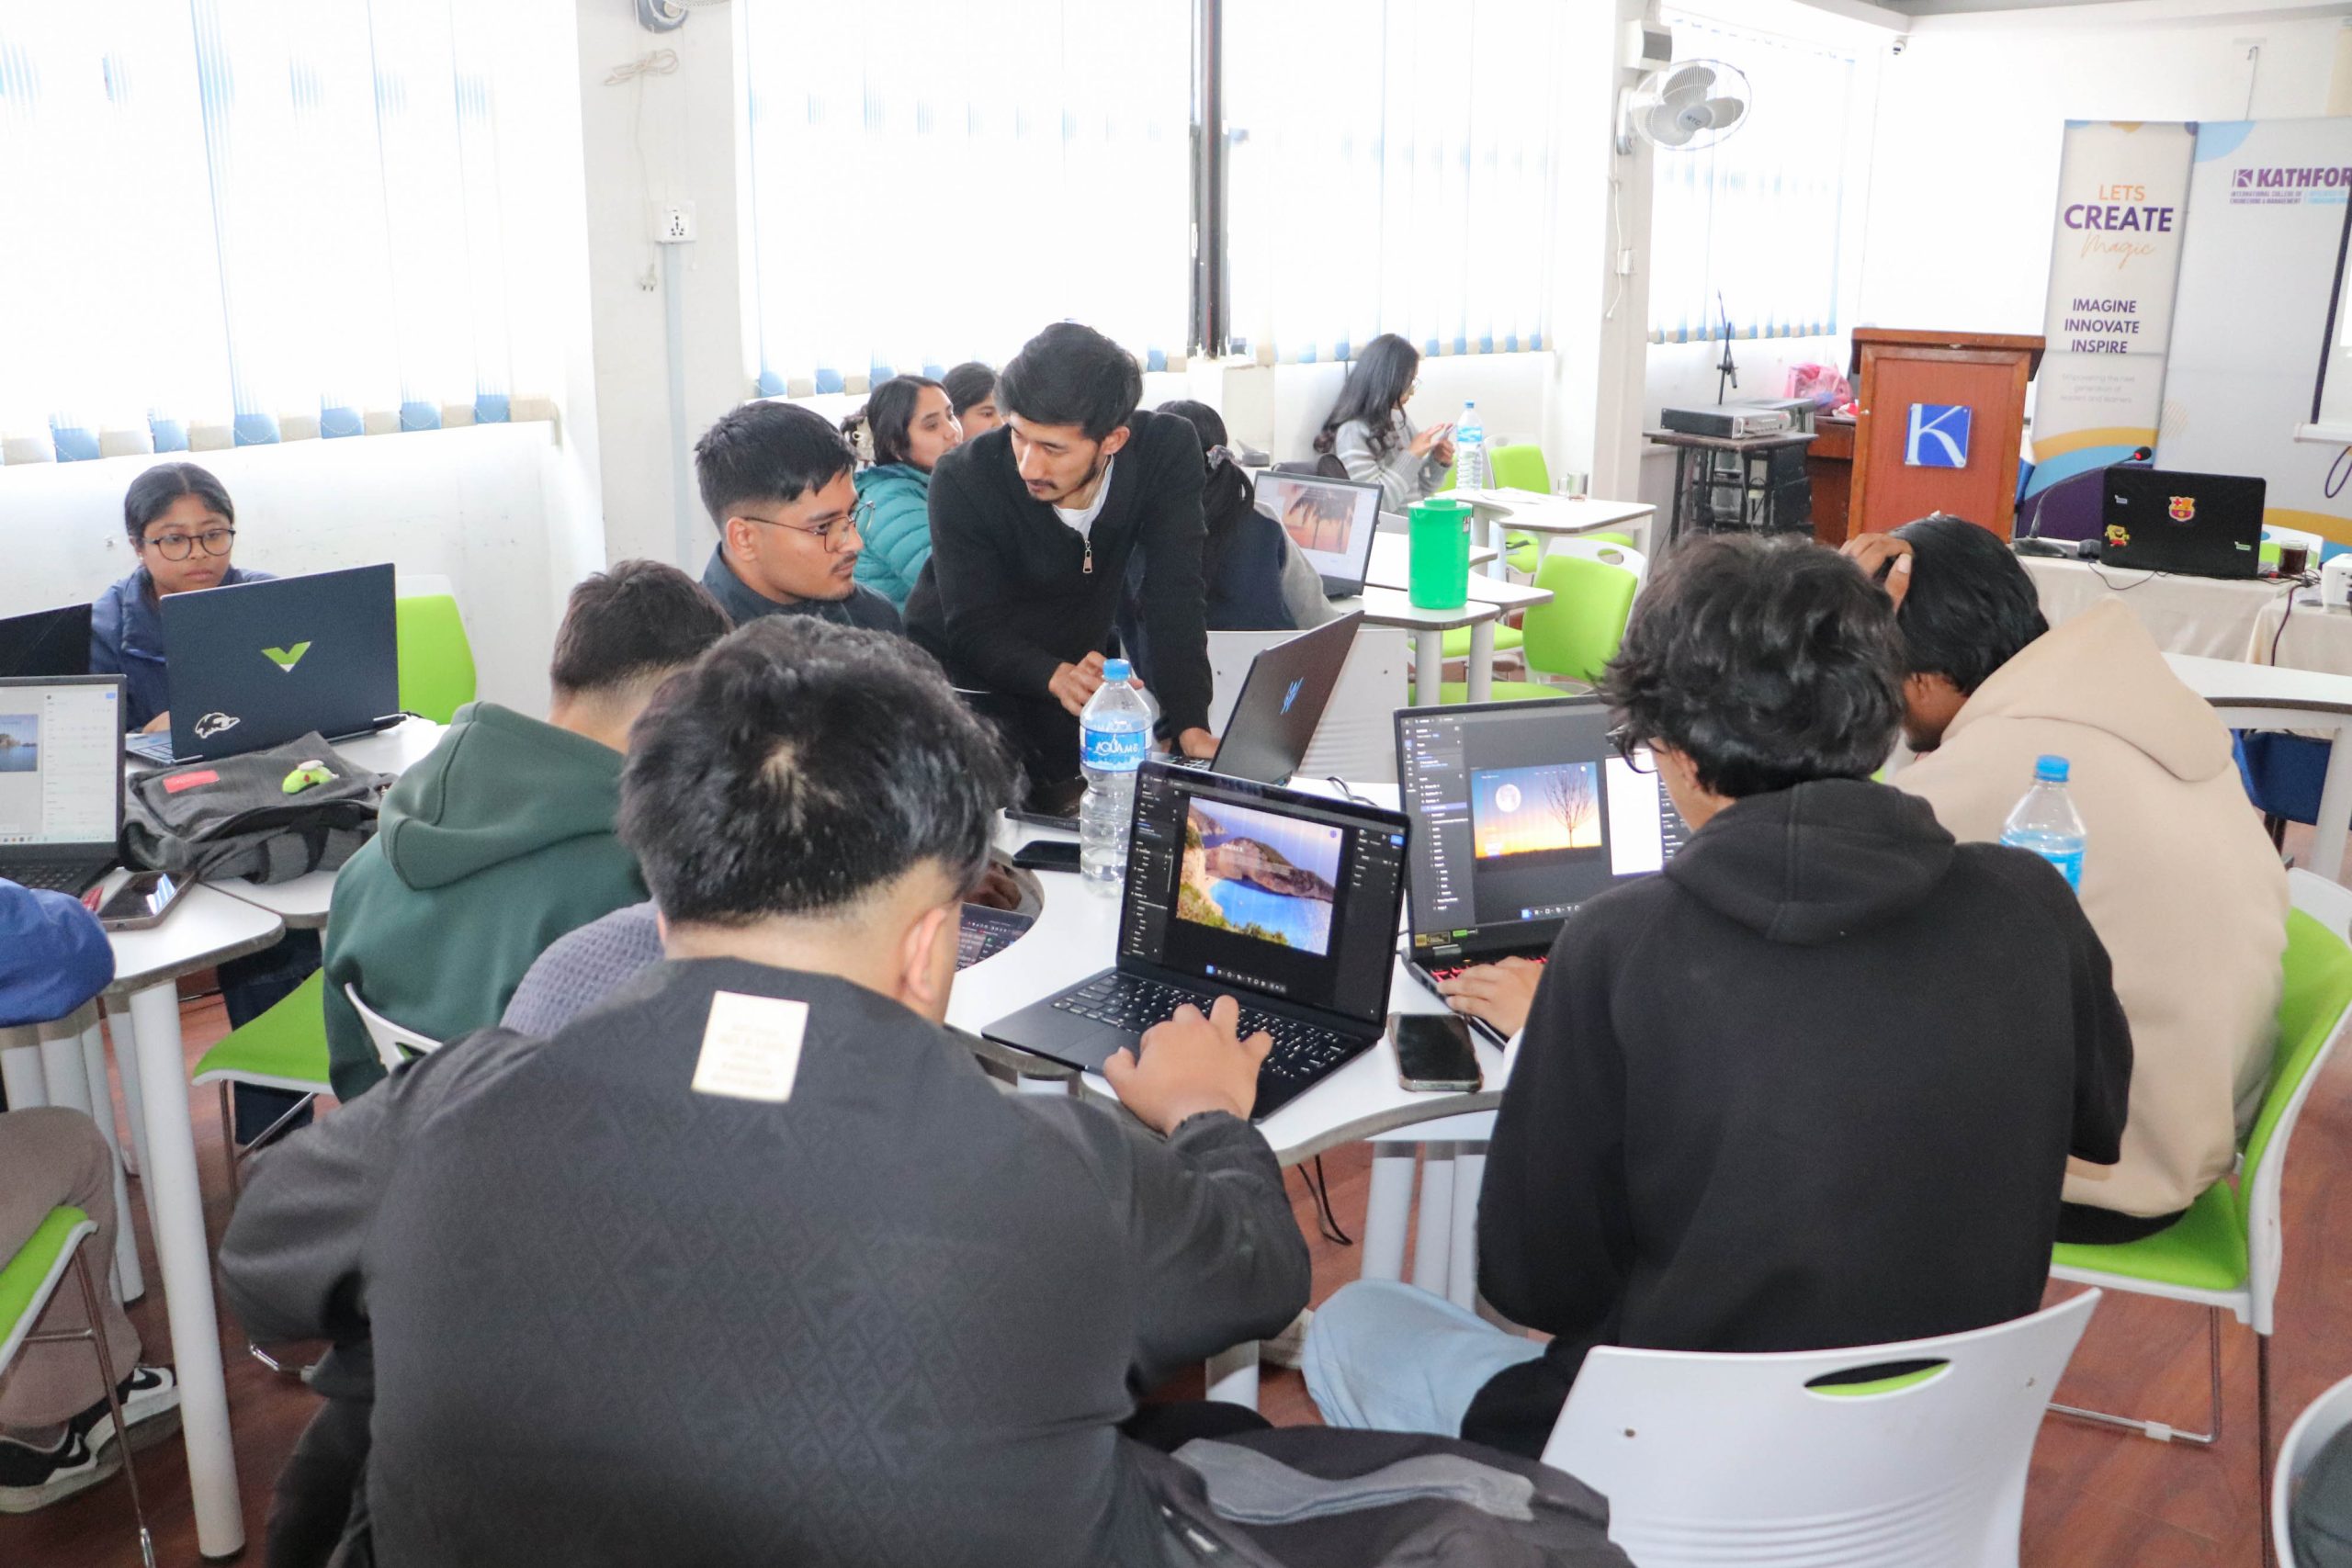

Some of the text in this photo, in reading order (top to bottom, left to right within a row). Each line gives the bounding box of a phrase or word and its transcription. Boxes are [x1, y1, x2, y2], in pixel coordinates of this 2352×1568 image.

[2098, 185, 2145, 201] LETS
[2064, 204, 2174, 231] CREATE
[2080, 231, 2155, 270] Magic
[2073, 298, 2137, 313] IMAGINE
[2064, 318, 2140, 333] INNOVATE
[2071, 339, 2128, 354] INSPIRE
